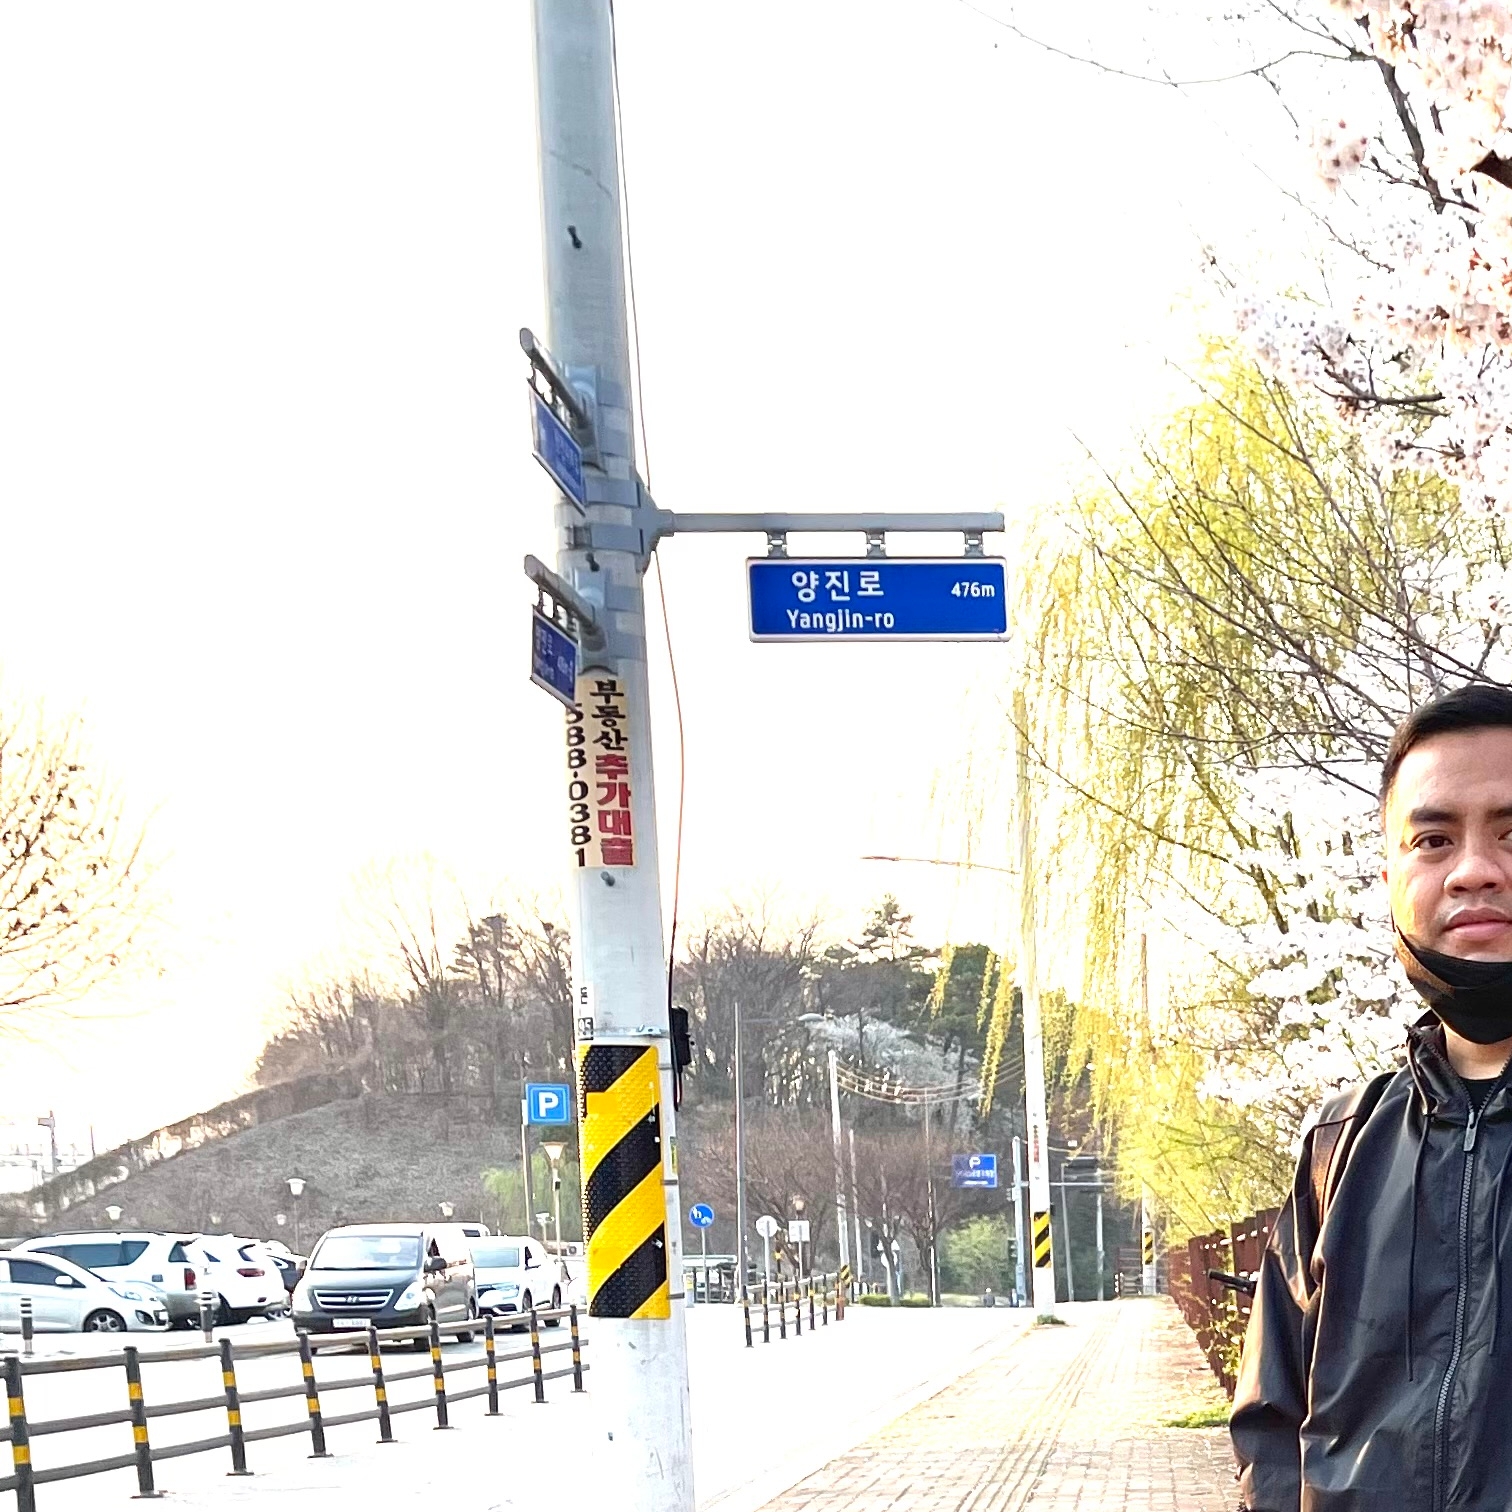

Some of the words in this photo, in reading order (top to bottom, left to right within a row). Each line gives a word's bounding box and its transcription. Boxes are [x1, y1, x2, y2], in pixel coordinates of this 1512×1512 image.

[791, 570, 885, 603] 양진로
[950, 582, 996, 598] 476m
[786, 608, 895, 633] Yangjin-ro
[589, 679, 629, 752] 부동산
[539, 1092, 559, 1118] P
